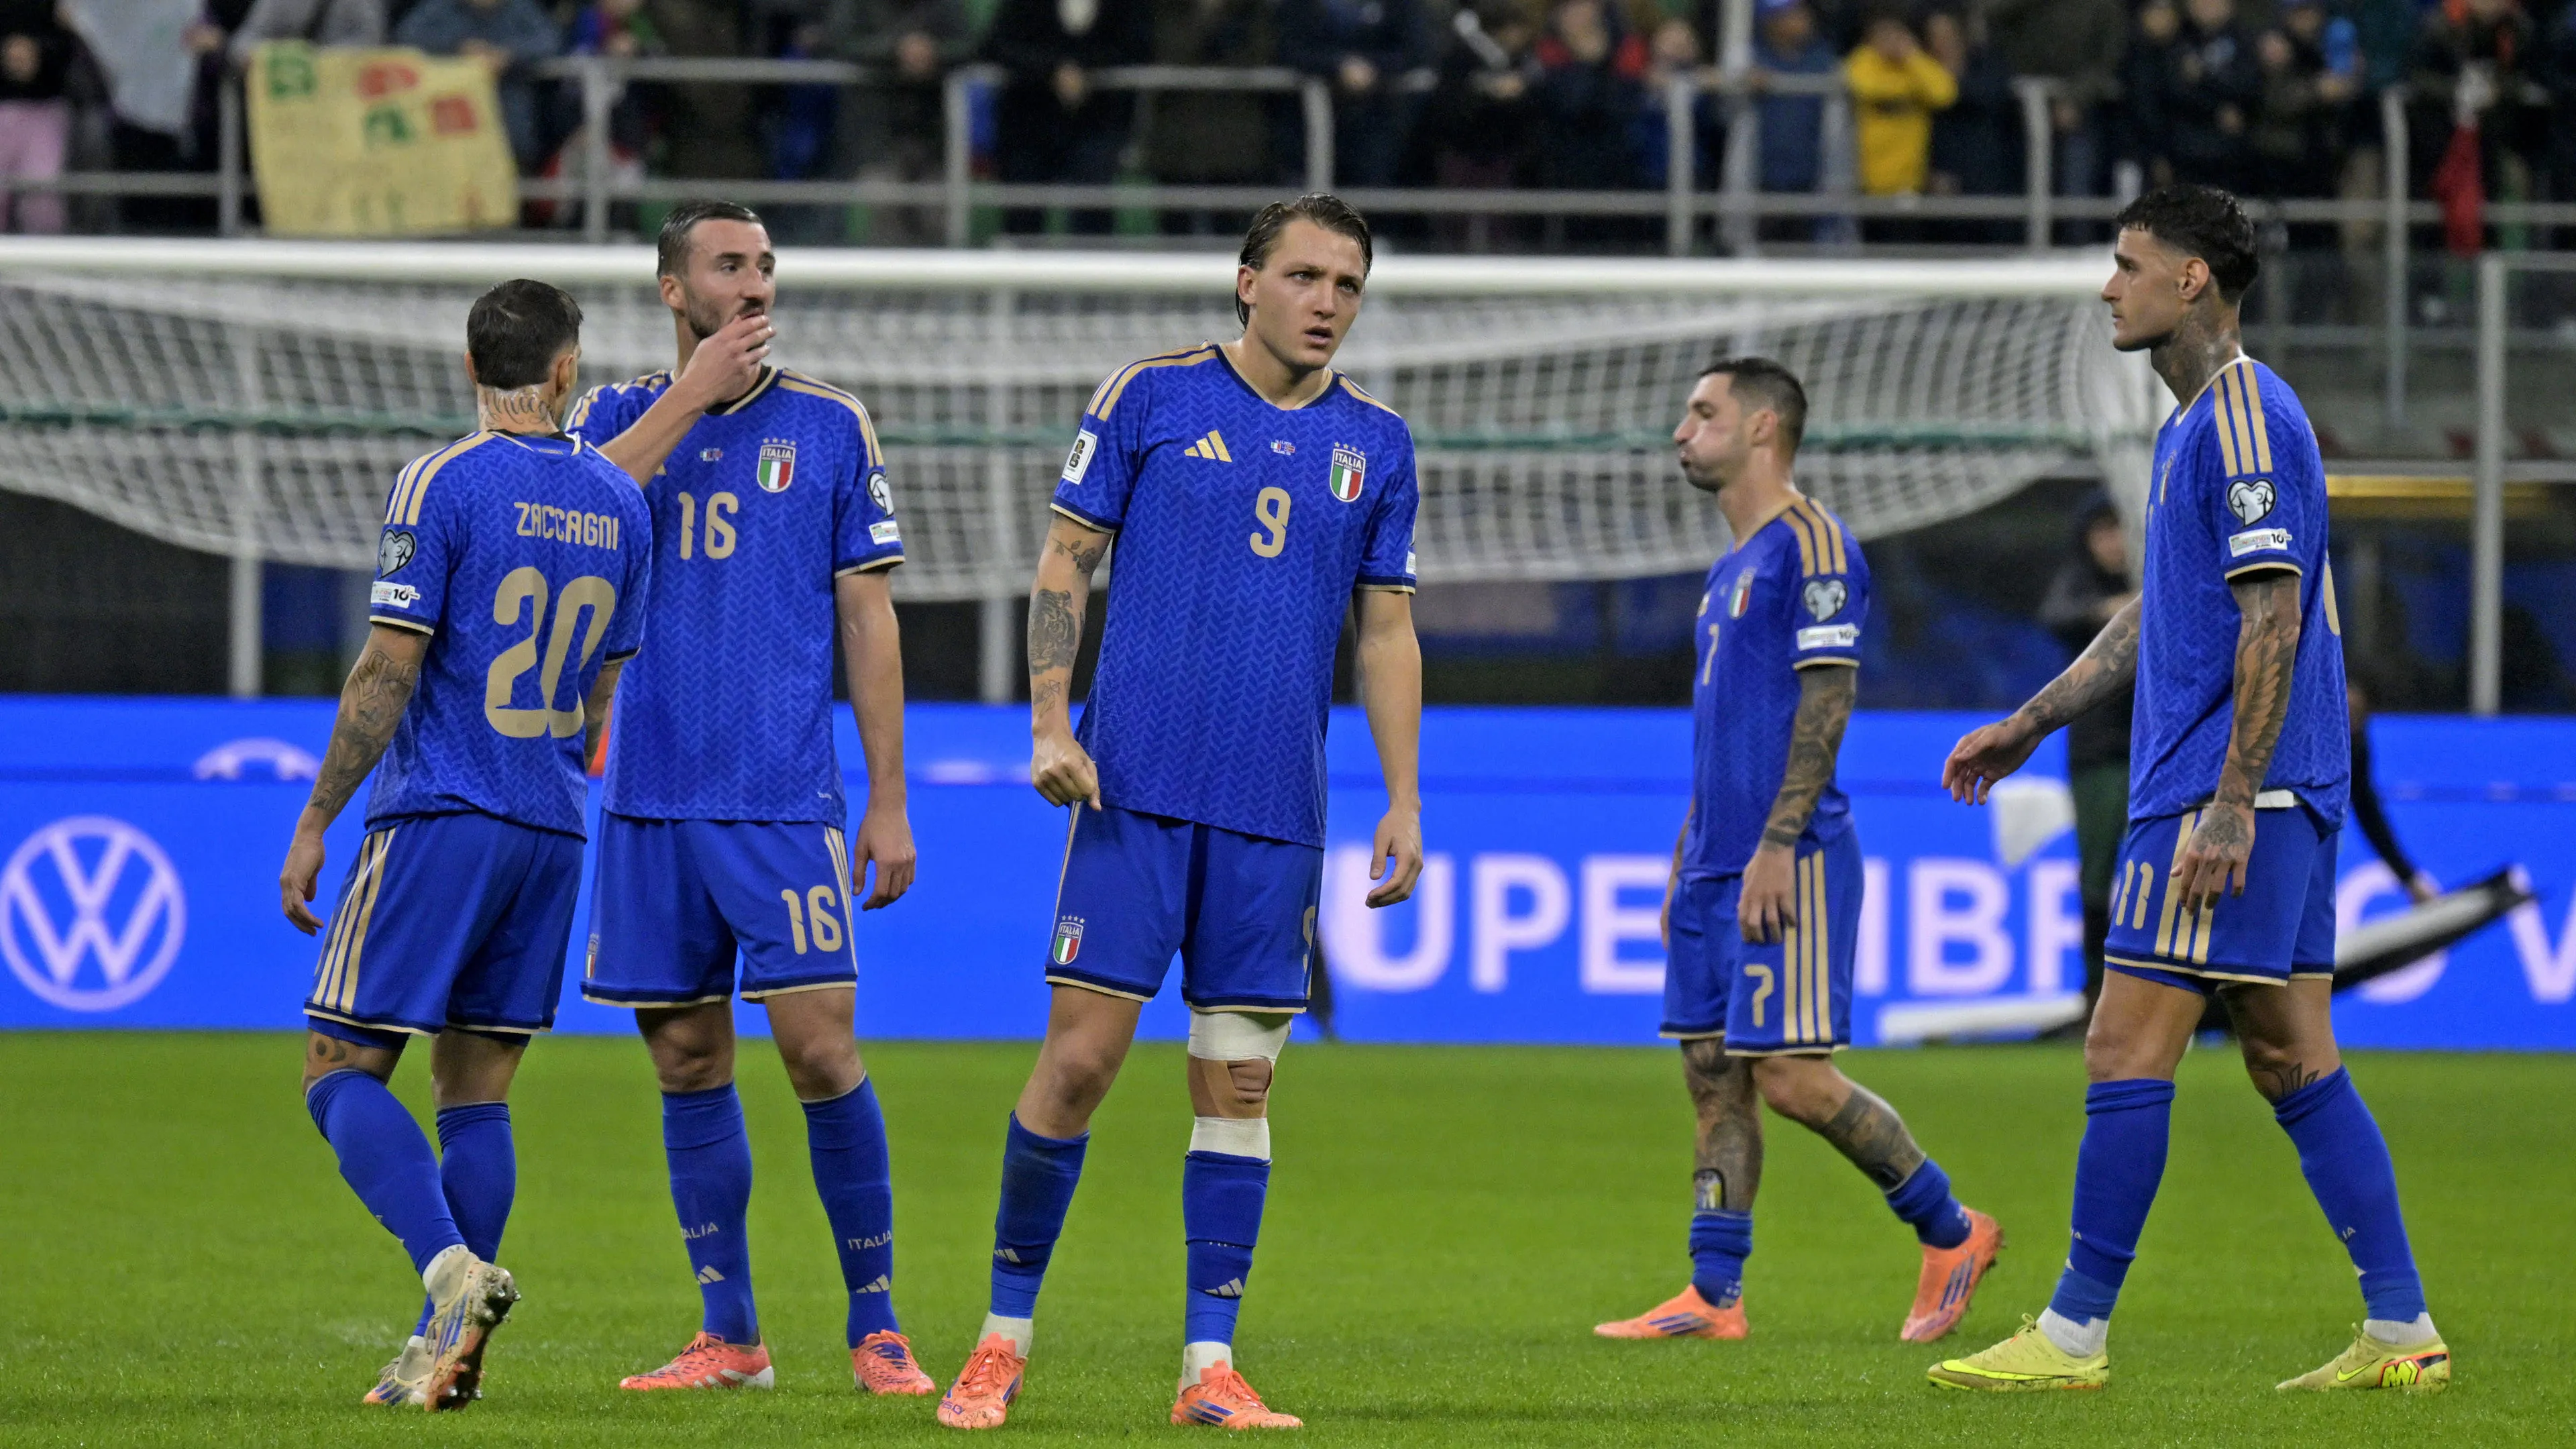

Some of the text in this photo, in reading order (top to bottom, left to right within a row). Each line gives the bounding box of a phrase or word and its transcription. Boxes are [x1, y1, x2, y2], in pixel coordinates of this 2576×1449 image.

[763, 447, 792, 459] ITALIA
[1336, 451, 1362, 470] ITALIA
[514, 501, 618, 550] ZACCAGNI
[678, 491, 739, 559] 16
[1250, 486, 1291, 557] 9
[484, 566, 616, 738] 20
[781, 885, 843, 955] 16
[1325, 847, 1670, 994] UPE
[2115, 859, 2154, 930] 11
[1060, 925, 1080, 936] ITALIA
[1744, 963, 1774, 1027] 7
[848, 1230, 892, 1250] ITALIA
